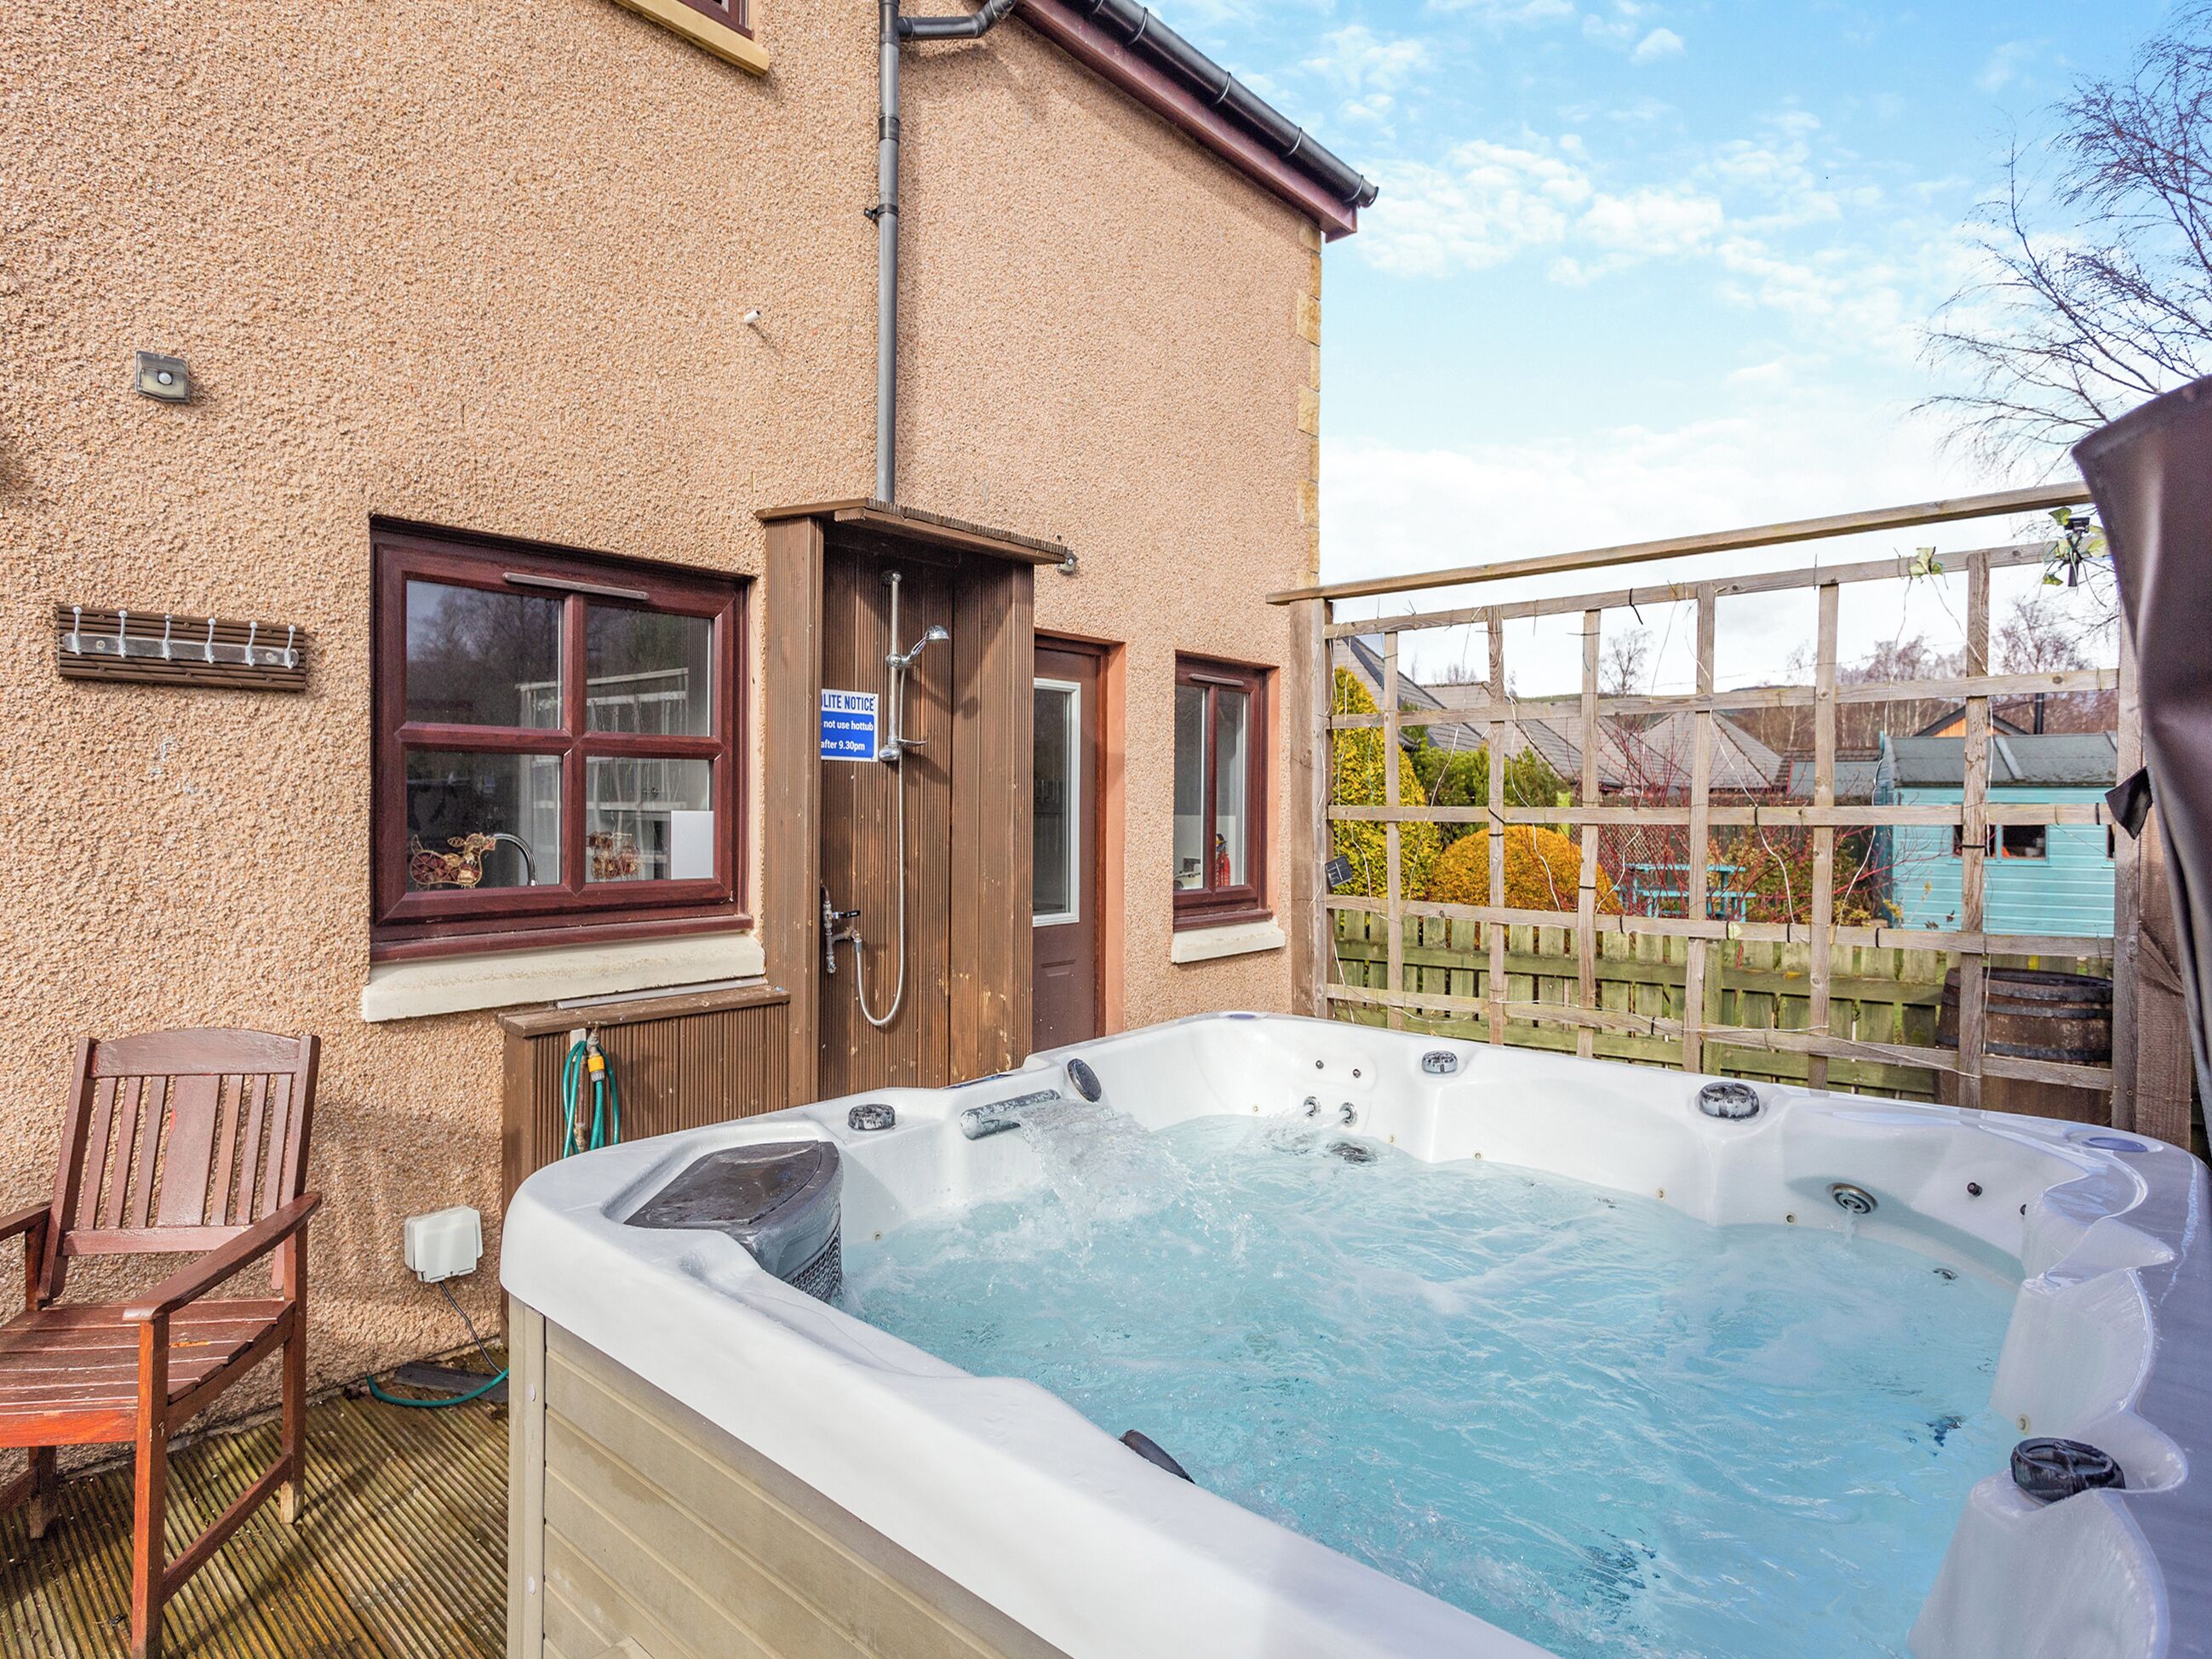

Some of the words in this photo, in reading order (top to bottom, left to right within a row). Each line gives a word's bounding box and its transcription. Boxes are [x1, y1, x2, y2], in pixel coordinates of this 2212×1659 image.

[821, 694, 841, 708] LITE
[845, 695, 874, 711] NOTICE
[823, 720, 835, 729] not
[837, 721, 850, 729] use
[851, 720, 874, 731] hottub
[821, 739, 837, 749] after
[839, 740, 865, 752] 9.30pm
